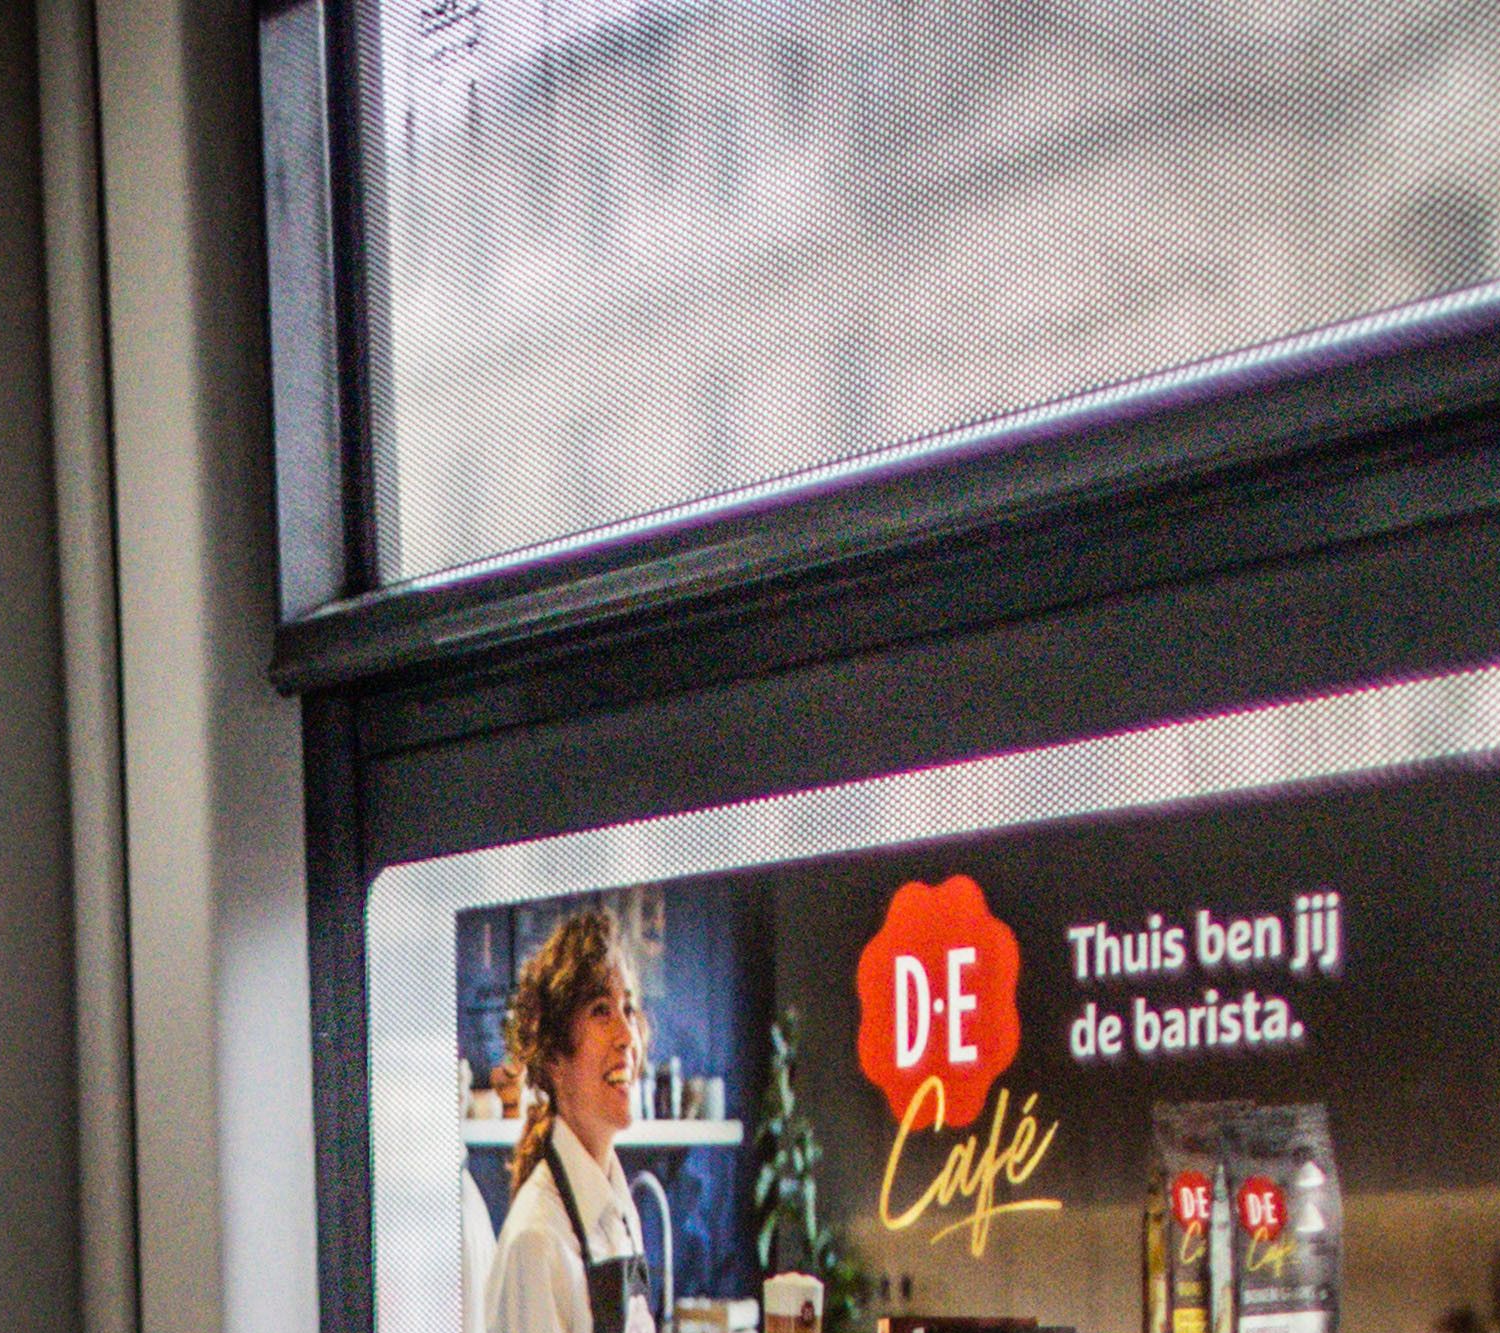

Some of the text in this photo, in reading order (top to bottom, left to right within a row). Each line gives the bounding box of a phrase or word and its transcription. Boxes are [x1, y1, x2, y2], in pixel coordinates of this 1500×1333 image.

[1067, 891, 1340, 979] Thuis ben jij
[1069, 988, 1305, 1057] de barista.
[879, 1075, 1063, 1257] Café
